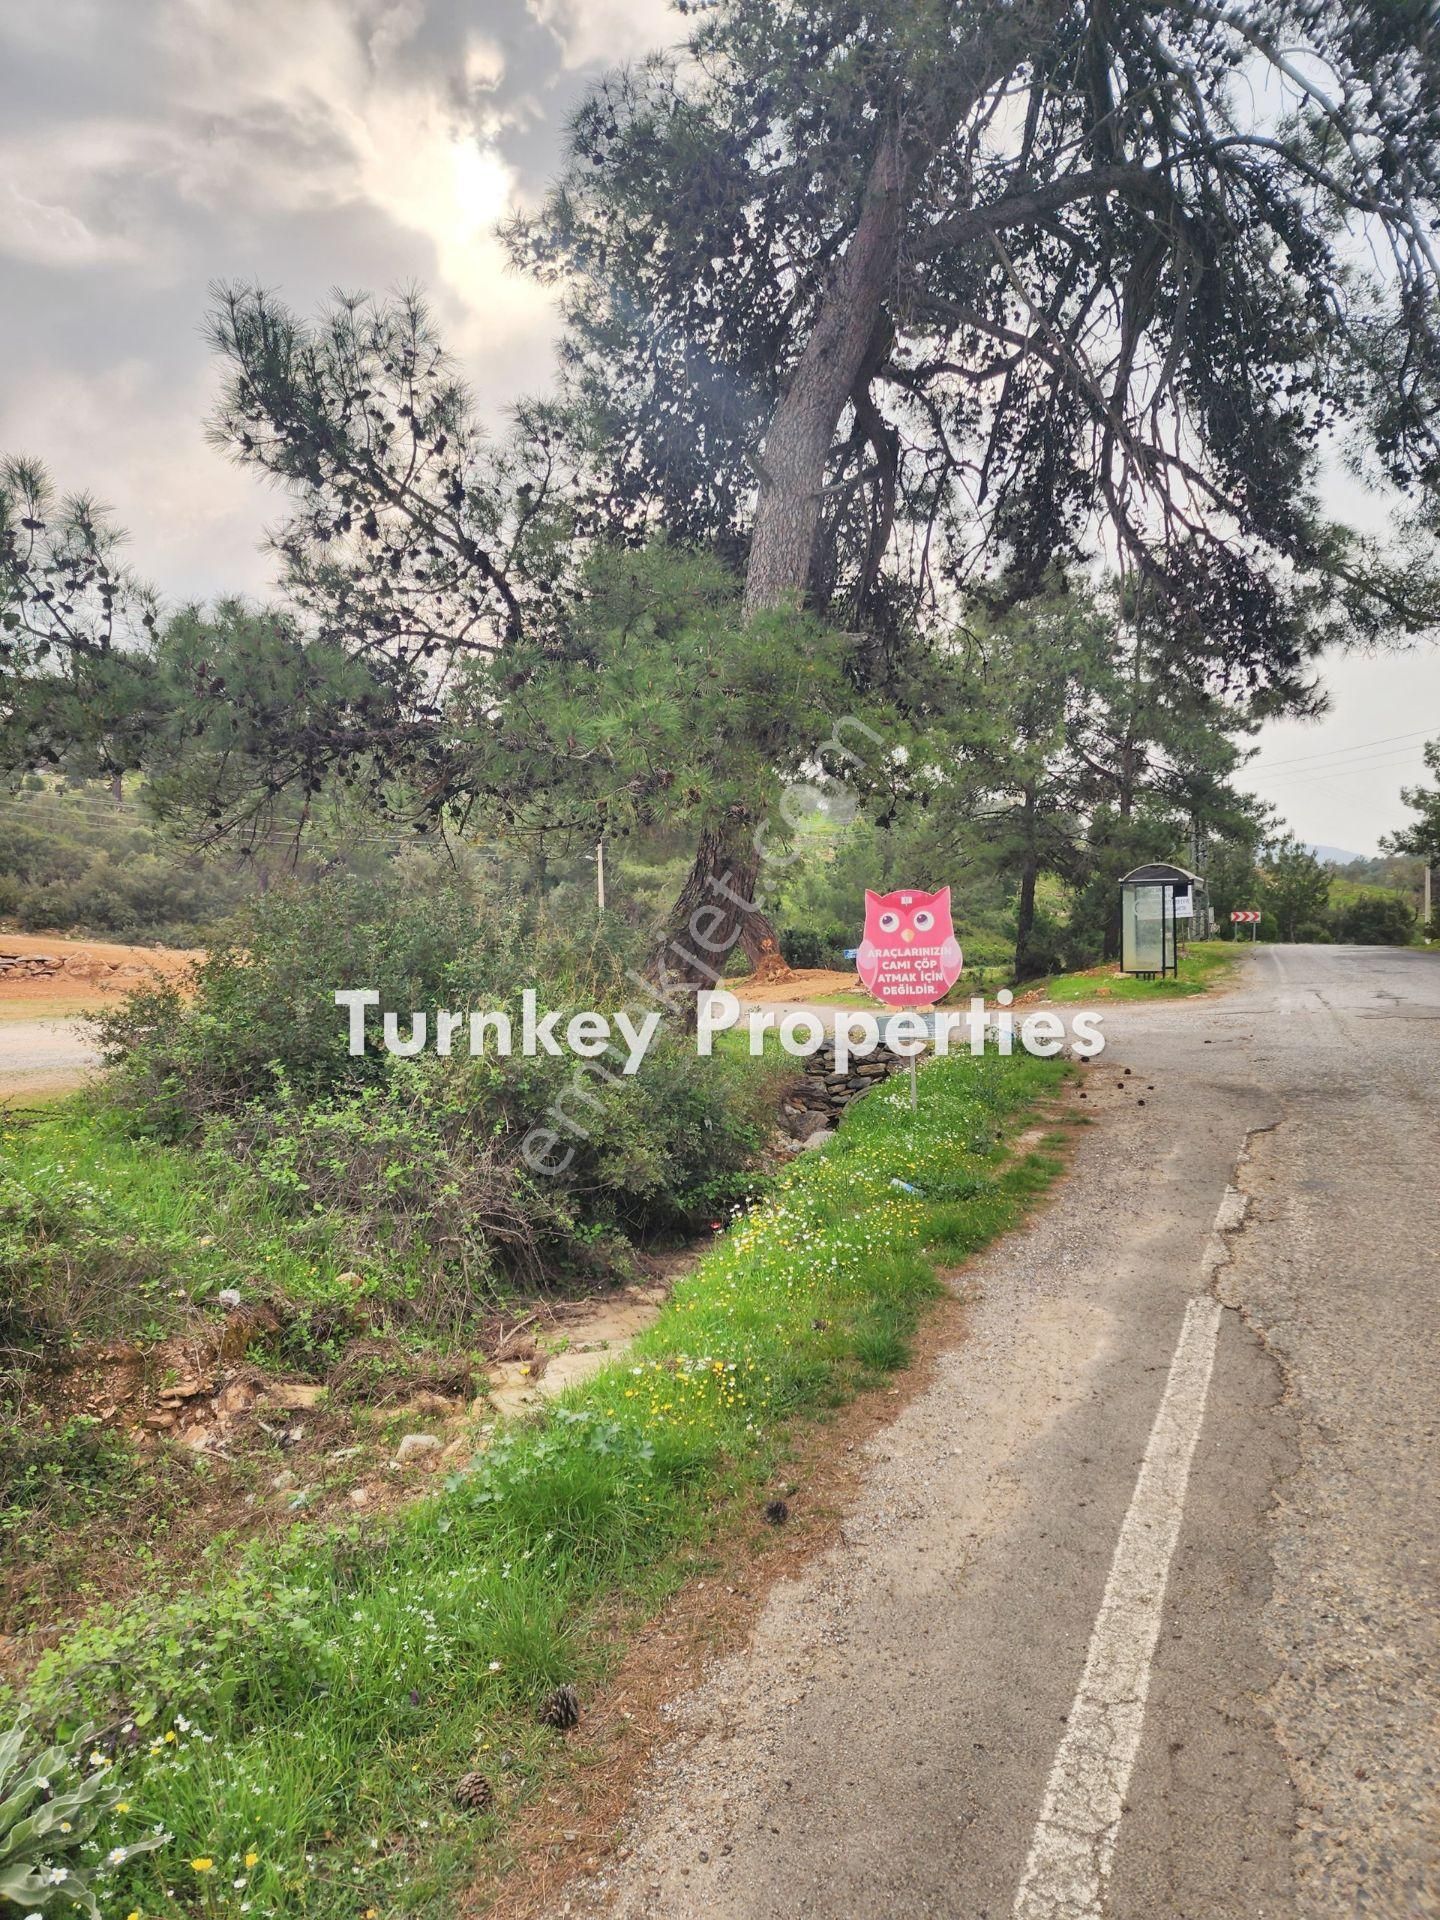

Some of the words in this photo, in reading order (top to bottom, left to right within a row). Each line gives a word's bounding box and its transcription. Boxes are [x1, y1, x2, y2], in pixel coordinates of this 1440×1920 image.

[868, 946, 952, 958] ARAÇLARINIZIN
[882, 961, 911, 970] CAMI
[914, 958, 937, 971] ÇÖP
[878, 973, 917, 982] ATMAK
[920, 970, 944, 983] İÇİN
[882, 984, 938, 995] DEĞİLDİR.
